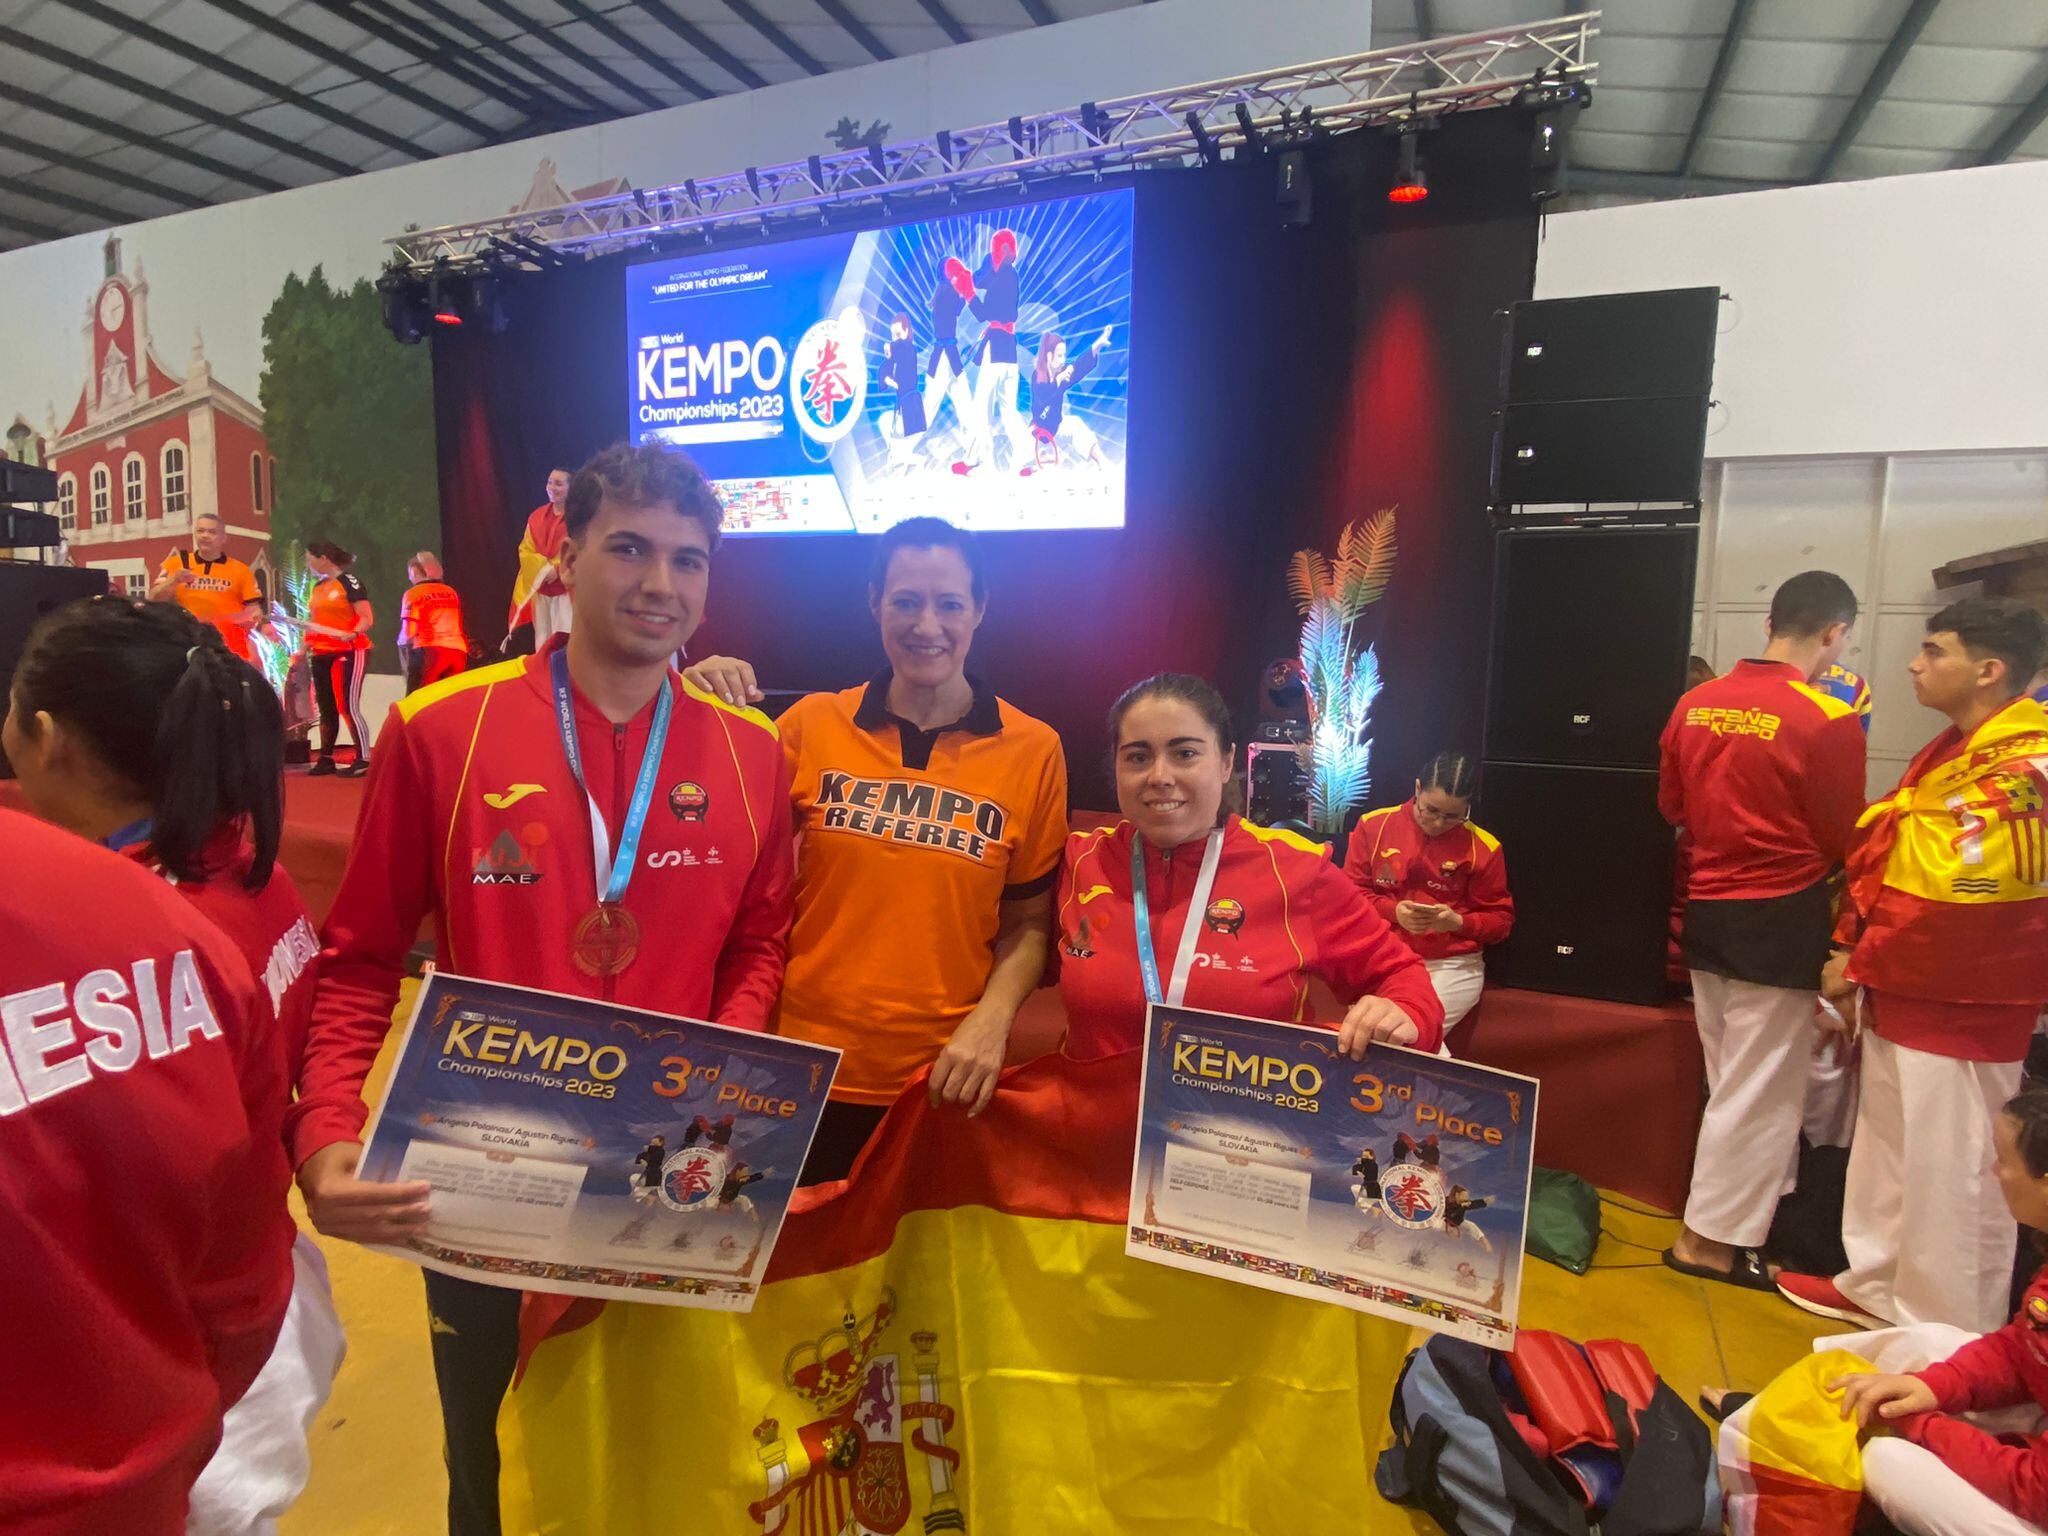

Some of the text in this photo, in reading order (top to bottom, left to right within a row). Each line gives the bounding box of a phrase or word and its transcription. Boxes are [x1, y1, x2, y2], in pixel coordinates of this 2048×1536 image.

[680, 281, 694, 291] FOR
[695, 279, 708, 289] THE
[709, 274, 739, 287] OLYMPIC
[661, 333, 684, 344] World
[638, 336, 785, 401] KEMPO
[639, 394, 784, 424] Championships 2023
[1573, 714, 1591, 724] RCF
[1710, 721, 1776, 740] KENPO
[813, 771, 1004, 841] KEMPO
[824, 806, 986, 860] REFEREE
[473, 873, 532, 884] MAE
[1556, 945, 1575, 955] RCF
[488, 1014, 517, 1026] World
[442, 1020, 628, 1081] KEMPO
[1200, 1036, 1223, 1047] World
[437, 1057, 616, 1100] Championships 2023
[652, 1055, 722, 1098] 3rd
[1173, 1041, 1323, 1096] KEMPO
[717, 1083, 797, 1118] Place
[1172, 1073, 1320, 1113] Championships 2023
[1350, 1073, 1413, 1113] 3rd
[1416, 1102, 1503, 1146] Place
[481, 1134, 530, 1148] SLOVAKIA
[1218, 1140, 1258, 1154] SLOVAKIA
